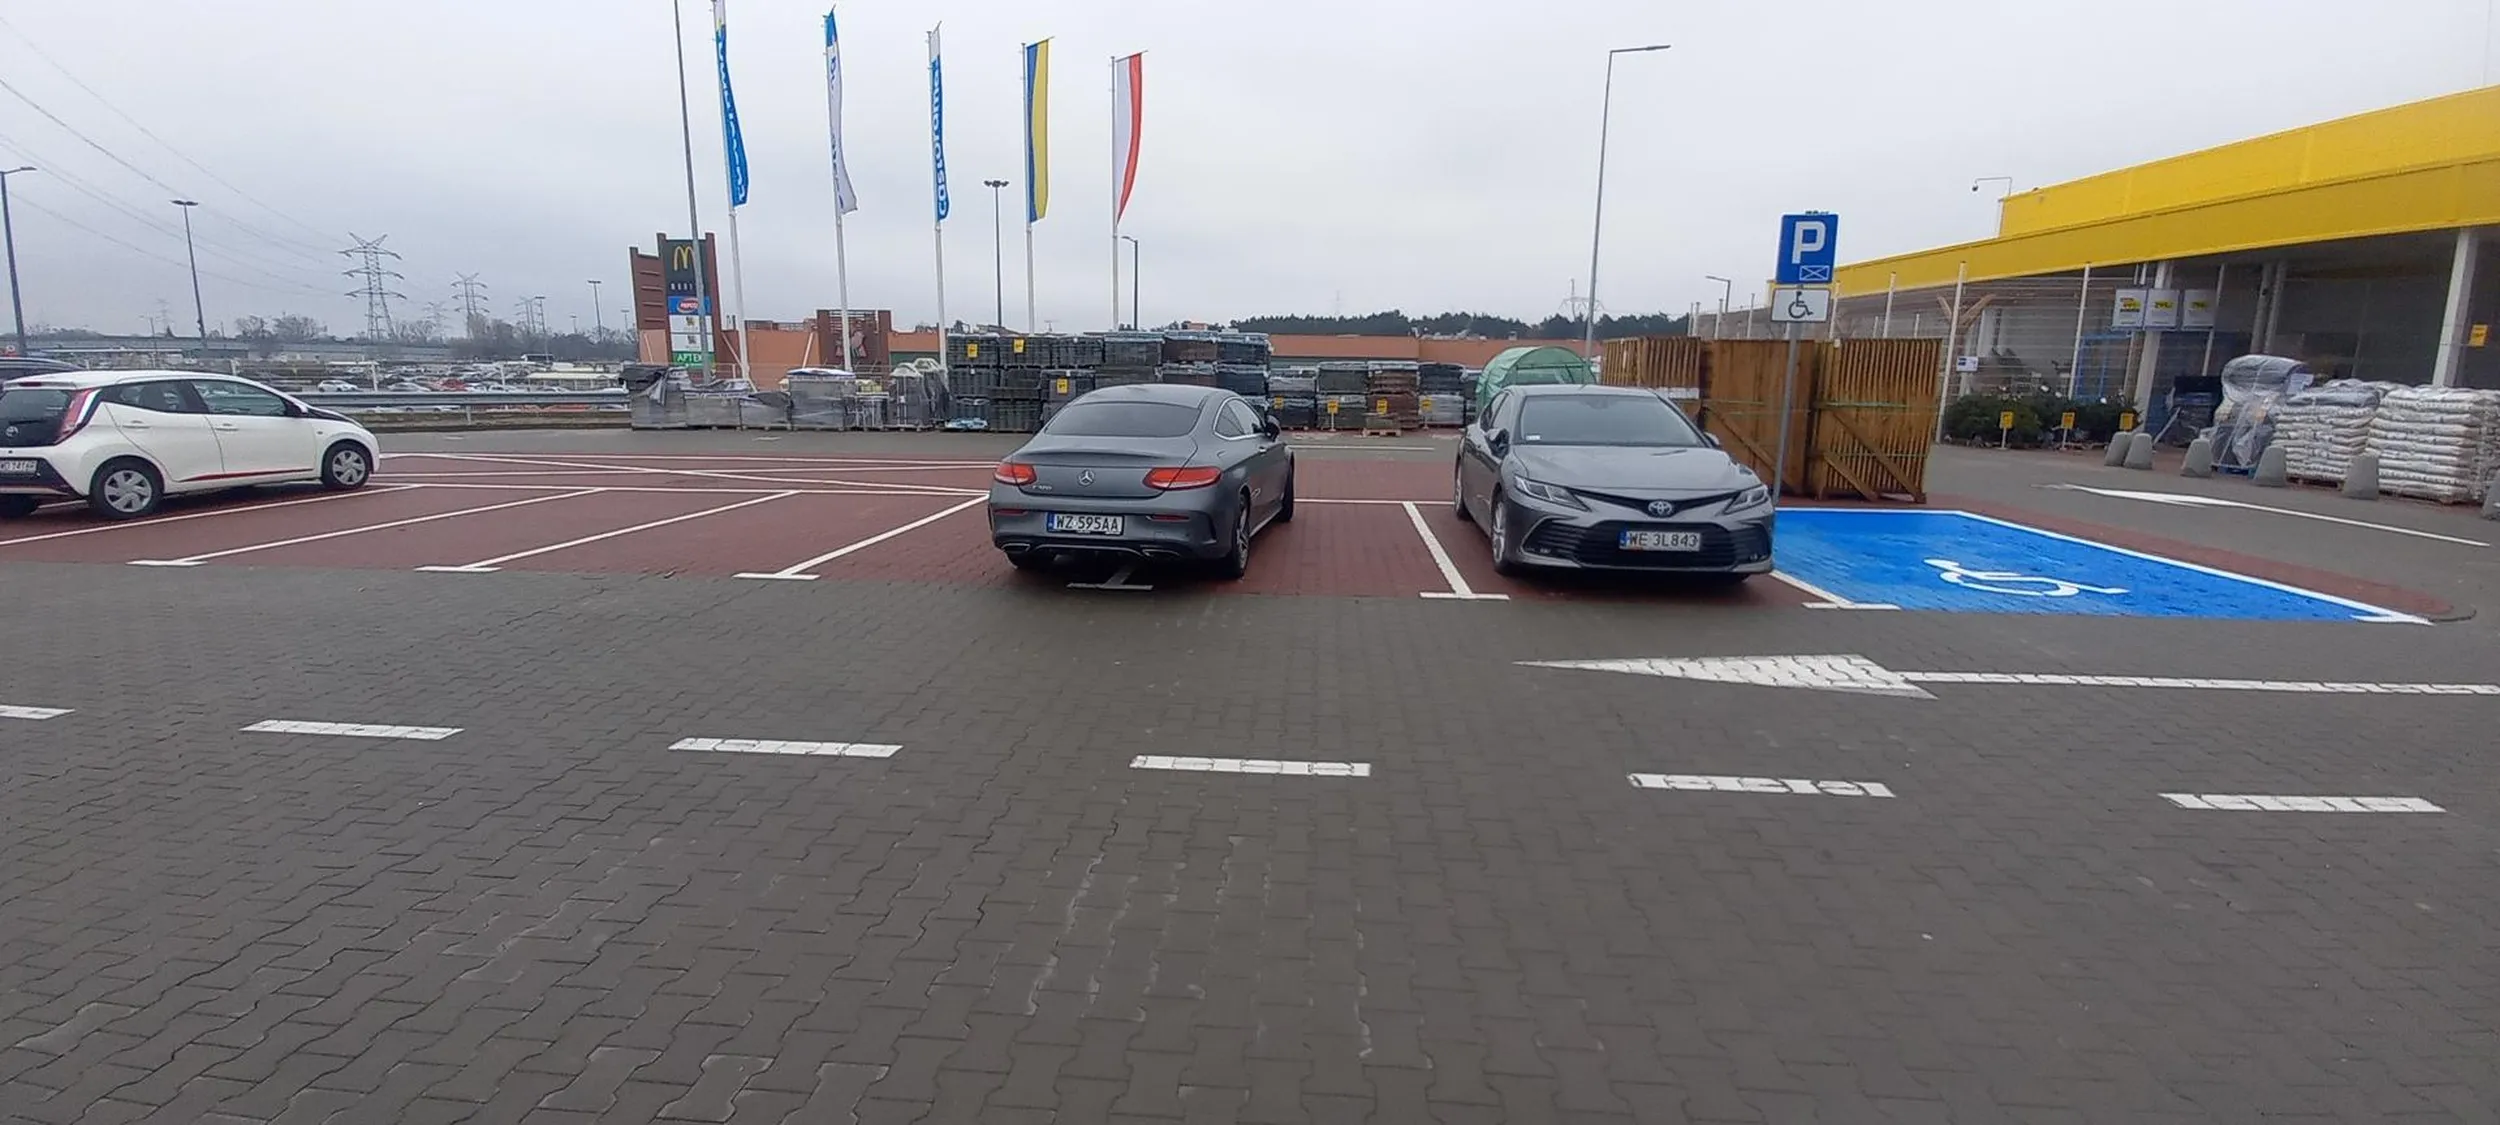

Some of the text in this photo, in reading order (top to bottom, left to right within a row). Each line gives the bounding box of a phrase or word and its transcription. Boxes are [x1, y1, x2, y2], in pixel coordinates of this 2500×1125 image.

[1791, 221, 1827, 265] P
[1056, 515, 1119, 532] WZ 595AA
[1629, 532, 1648, 547] WE
